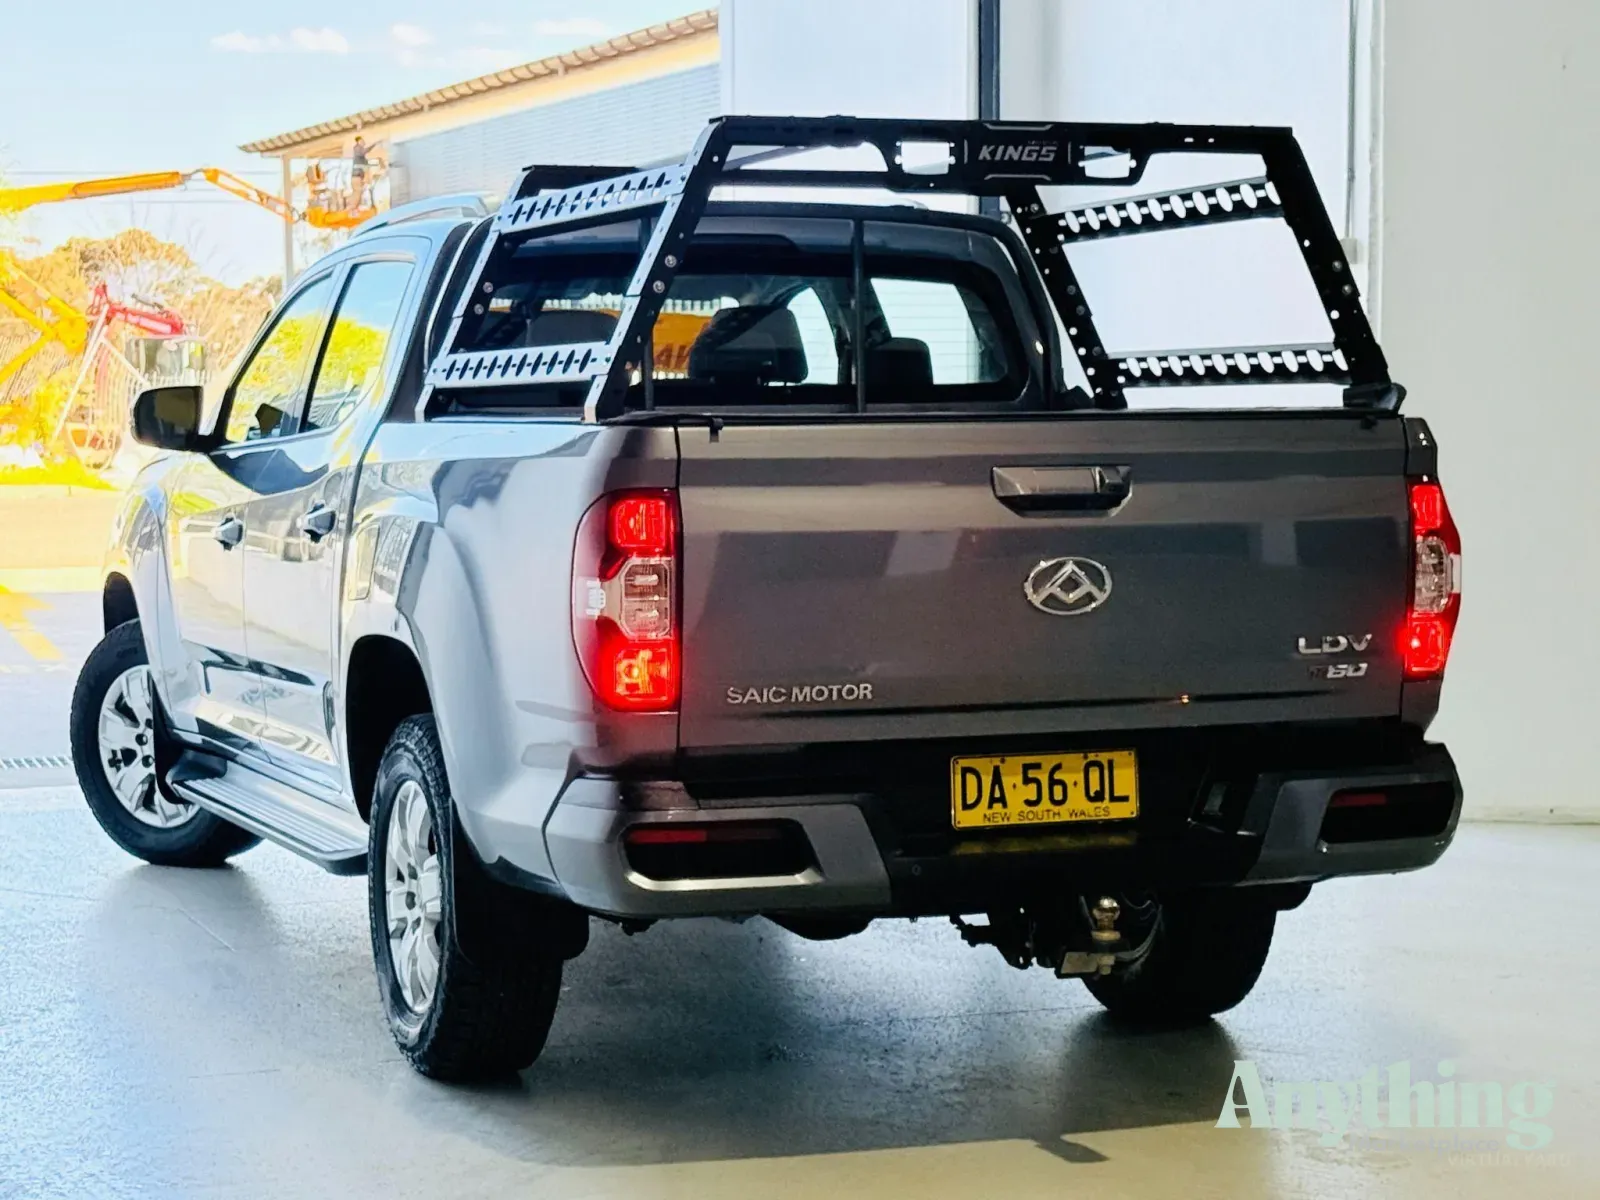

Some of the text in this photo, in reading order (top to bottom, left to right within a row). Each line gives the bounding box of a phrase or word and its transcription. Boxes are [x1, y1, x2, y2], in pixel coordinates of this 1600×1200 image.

[978, 144, 1057, 162] KINGS
[1298, 633, 1373, 654] LDV
[726, 683, 873, 704] SAIC MOTOR
[983, 806, 1111, 824] NEW SOUTH WALES
